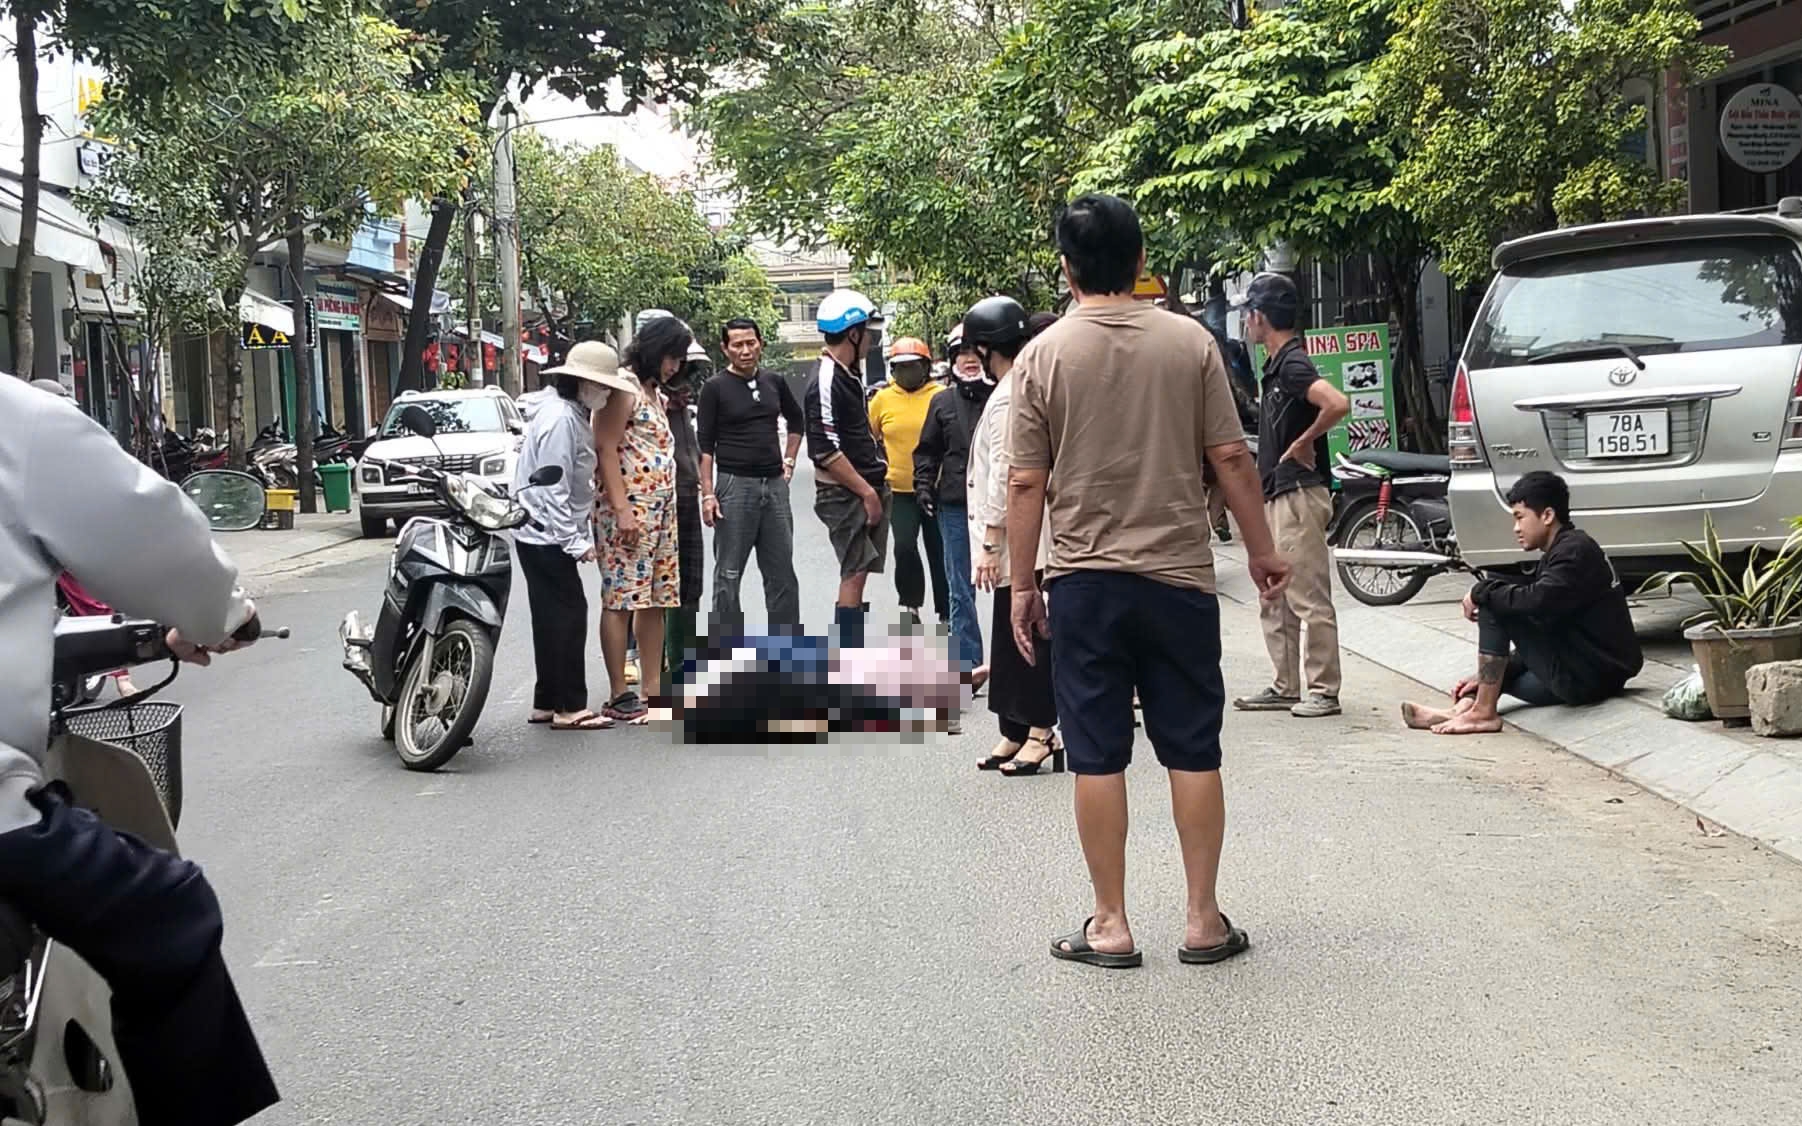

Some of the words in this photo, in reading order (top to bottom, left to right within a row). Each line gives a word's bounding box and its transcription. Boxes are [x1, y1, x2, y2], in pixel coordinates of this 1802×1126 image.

[1345, 331, 1382, 353] SPA
[1609, 414, 1644, 433] 78A
[1598, 433, 1657, 453] 158.51
